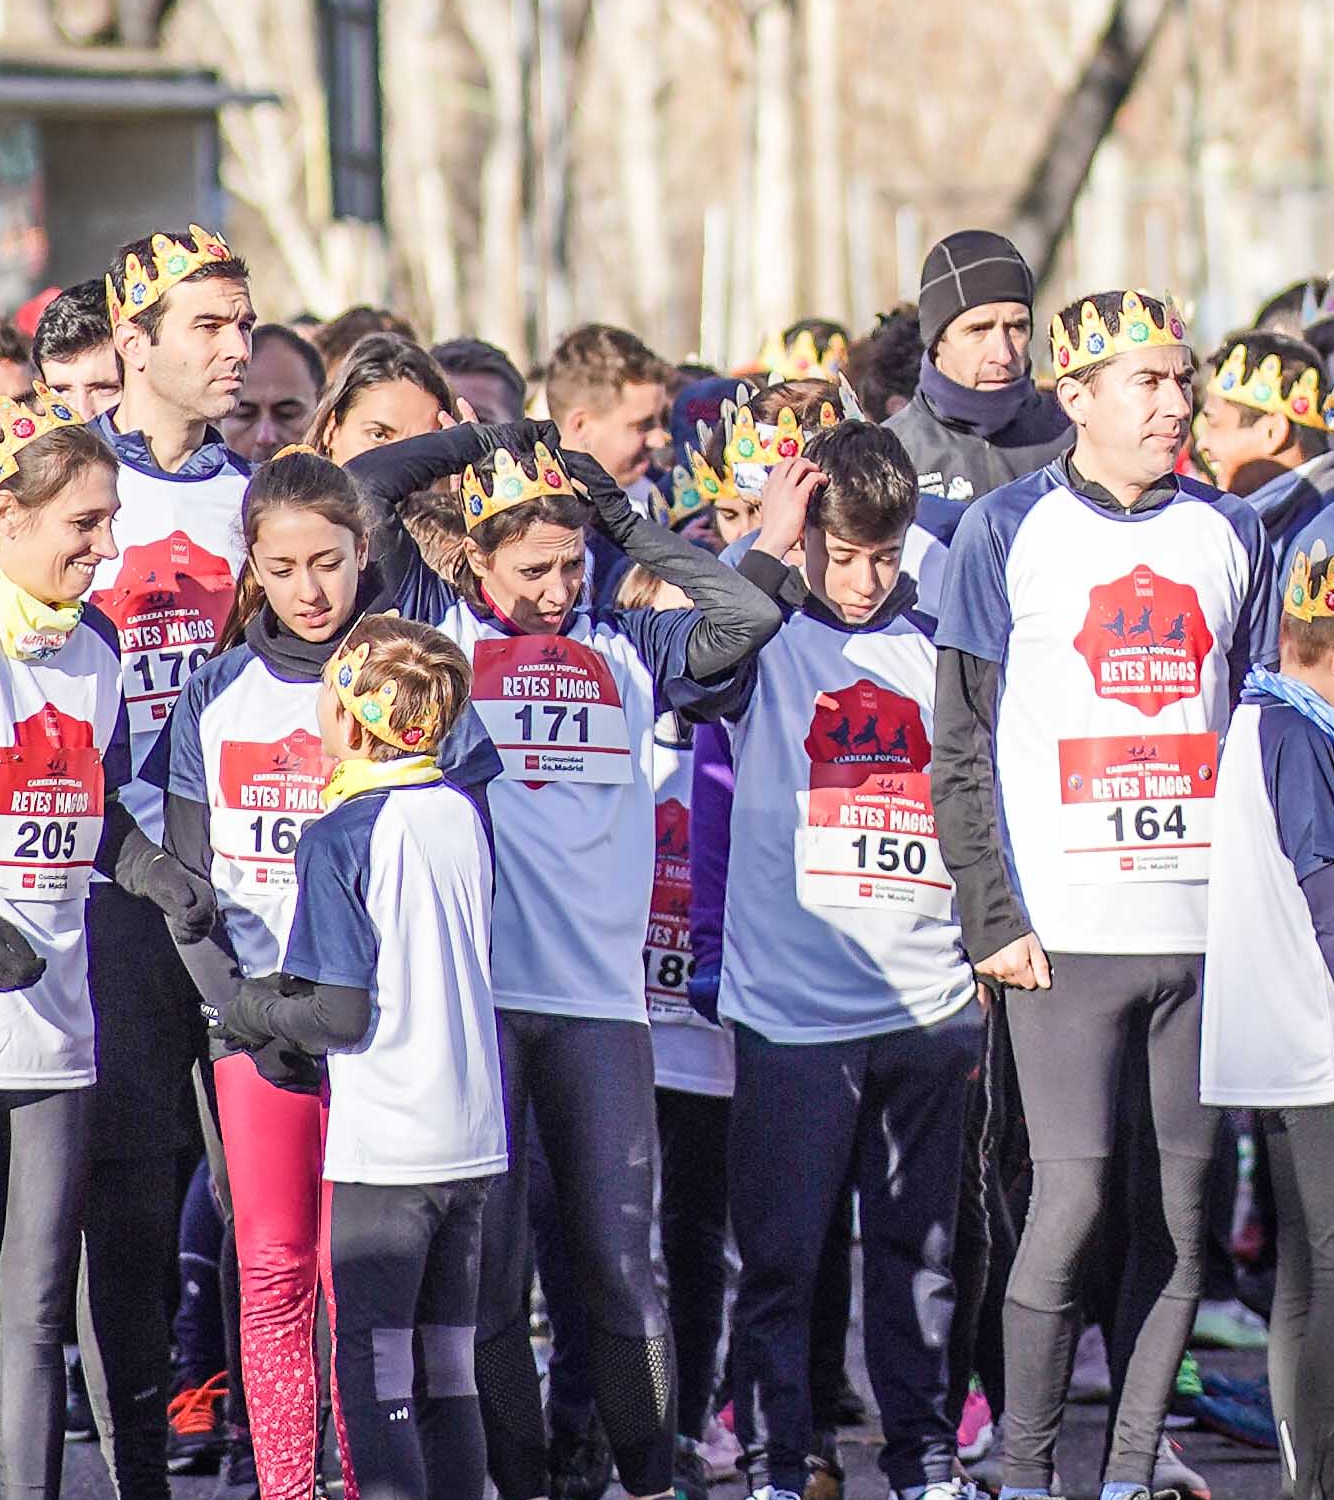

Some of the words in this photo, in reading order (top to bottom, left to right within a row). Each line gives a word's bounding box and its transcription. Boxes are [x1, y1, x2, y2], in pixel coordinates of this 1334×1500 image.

[167, 619, 215, 645] MAGOS
[1100, 661, 1145, 683] REYES
[1150, 661, 1196, 682] MAGOS
[502, 676, 550, 698] REYES
[555, 678, 601, 700] MAGOS
[515, 704, 589, 744] 171
[240, 784, 280, 808] REYES
[1092, 777, 1140, 799] REYES
[1145, 775, 1192, 797] MAGOS
[11, 791, 51, 812] REYES
[840, 805, 885, 829] REYES
[890, 808, 934, 834] MAGOS
[1107, 804, 1187, 842] 164
[14, 821, 77, 860] 205
[852, 834, 926, 875] 150
